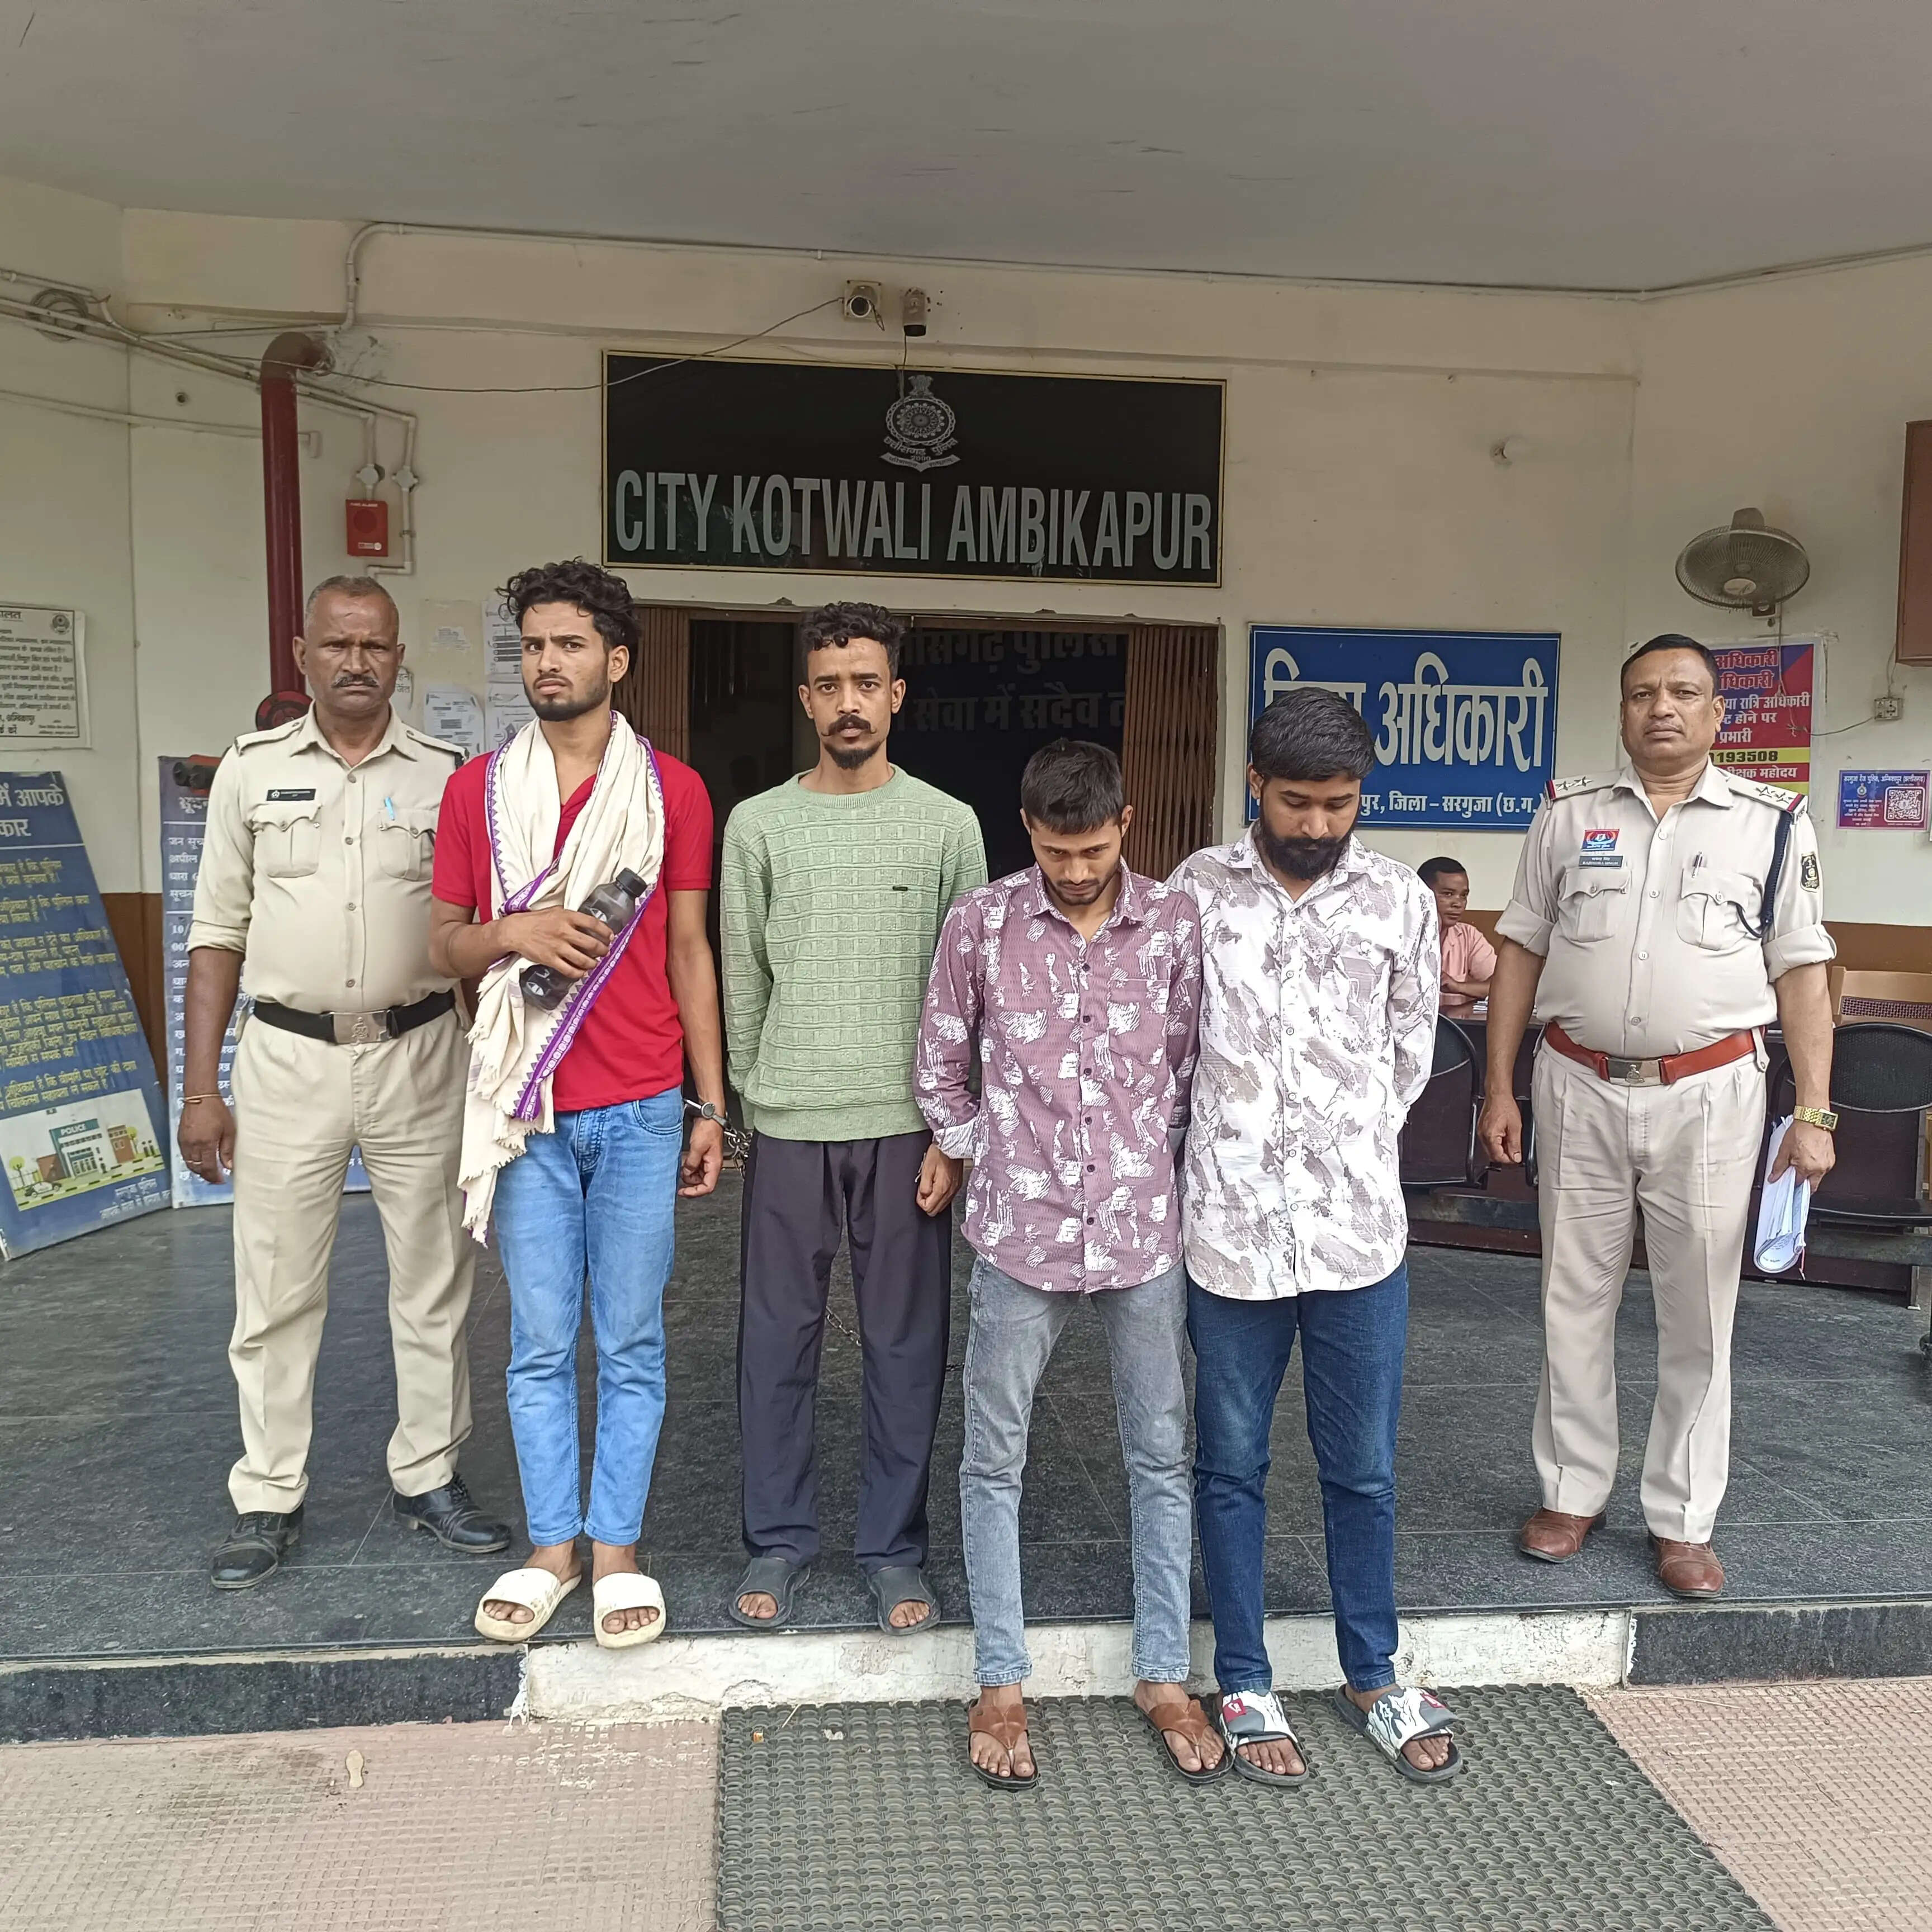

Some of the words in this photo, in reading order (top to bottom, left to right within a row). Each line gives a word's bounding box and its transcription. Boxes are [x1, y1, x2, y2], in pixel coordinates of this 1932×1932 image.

[615, 470, 718, 552] CITY
[732, 474, 930, 560] KOTWALI
[946, 485, 1211, 570] AMBIKAPUR
[1740, 694, 1761, 709] रात्रि
[1763, 692, 1811, 708] अधिकारी
[1375, 652, 1548, 773] अधिकारी
[1735, 711, 1758, 724] होने
[1761, 712, 1778, 723] पर
[1719, 728, 1753, 744] प्रभारी
[1760, 765, 1798, 779] महोदय
[15, 783, 64, 807] आपके
[1389, 790, 1427, 811] जिला
[1442, 796, 1493, 818] सरगुजा
[0, 819, 32, 837] कार
[188, 837, 204, 849] सूच
[169, 889, 195, 902] सूचन
[60, 1123, 86, 1135] POLICE
